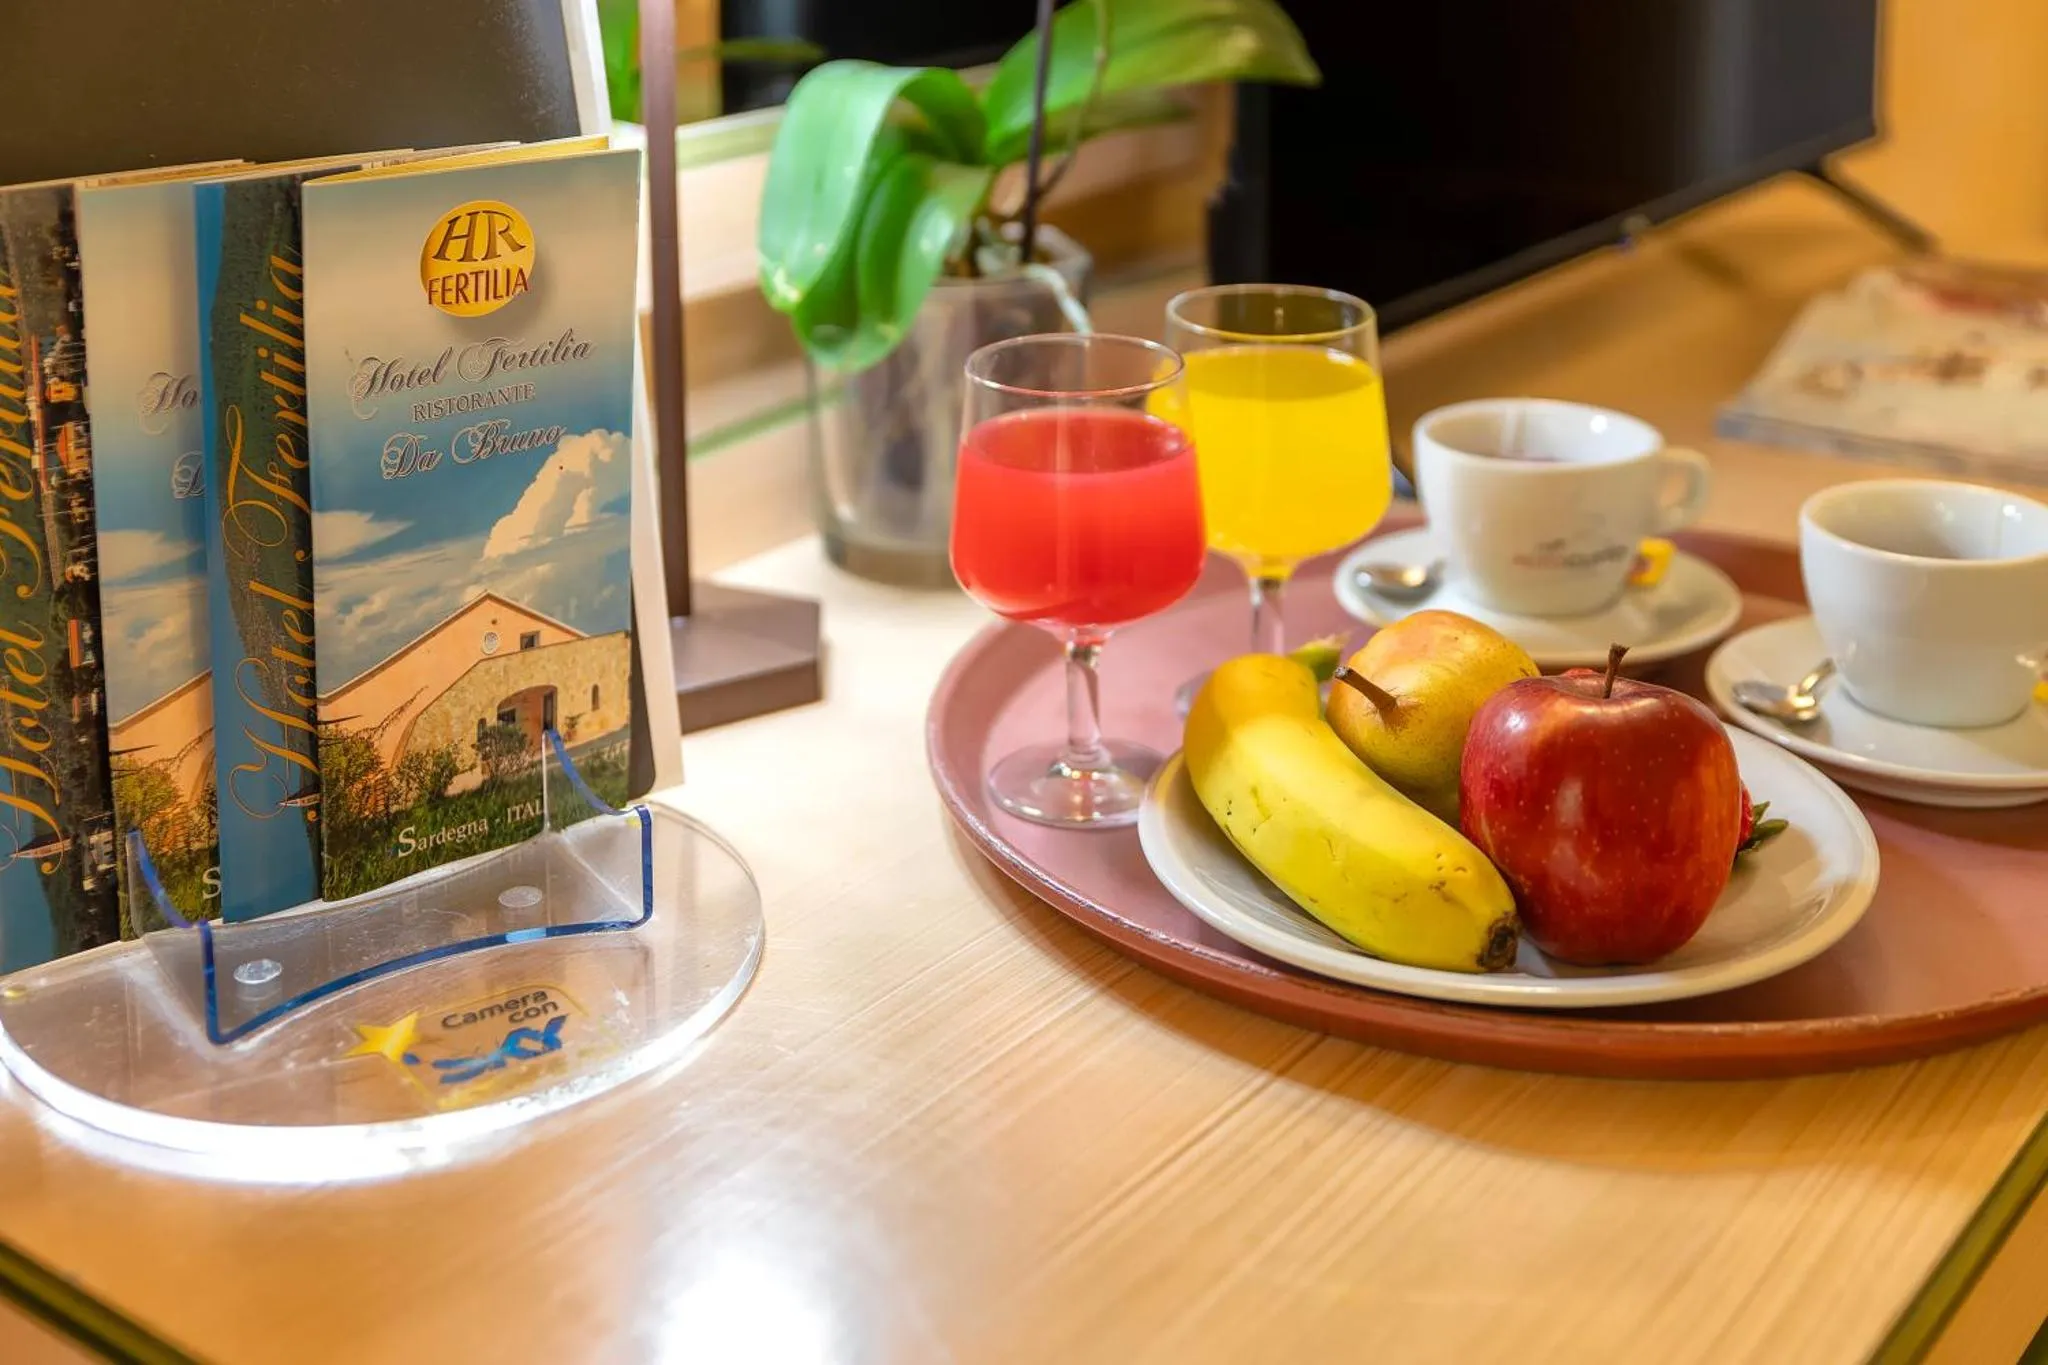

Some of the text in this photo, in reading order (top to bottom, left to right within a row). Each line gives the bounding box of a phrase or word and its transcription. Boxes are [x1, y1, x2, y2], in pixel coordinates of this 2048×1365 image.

[432, 210, 526, 262] HR
[427, 267, 529, 305] FERTILIA
[349, 327, 597, 420] Hotel Fertilia
[413, 383, 536, 422] RISTORANTE
[381, 419, 566, 479] Da Bruno
[397, 817, 489, 857] Sardegna
[507, 800, 545, 824] ITAL
[441, 989, 549, 1030] Camera
[508, 999, 559, 1025] con
